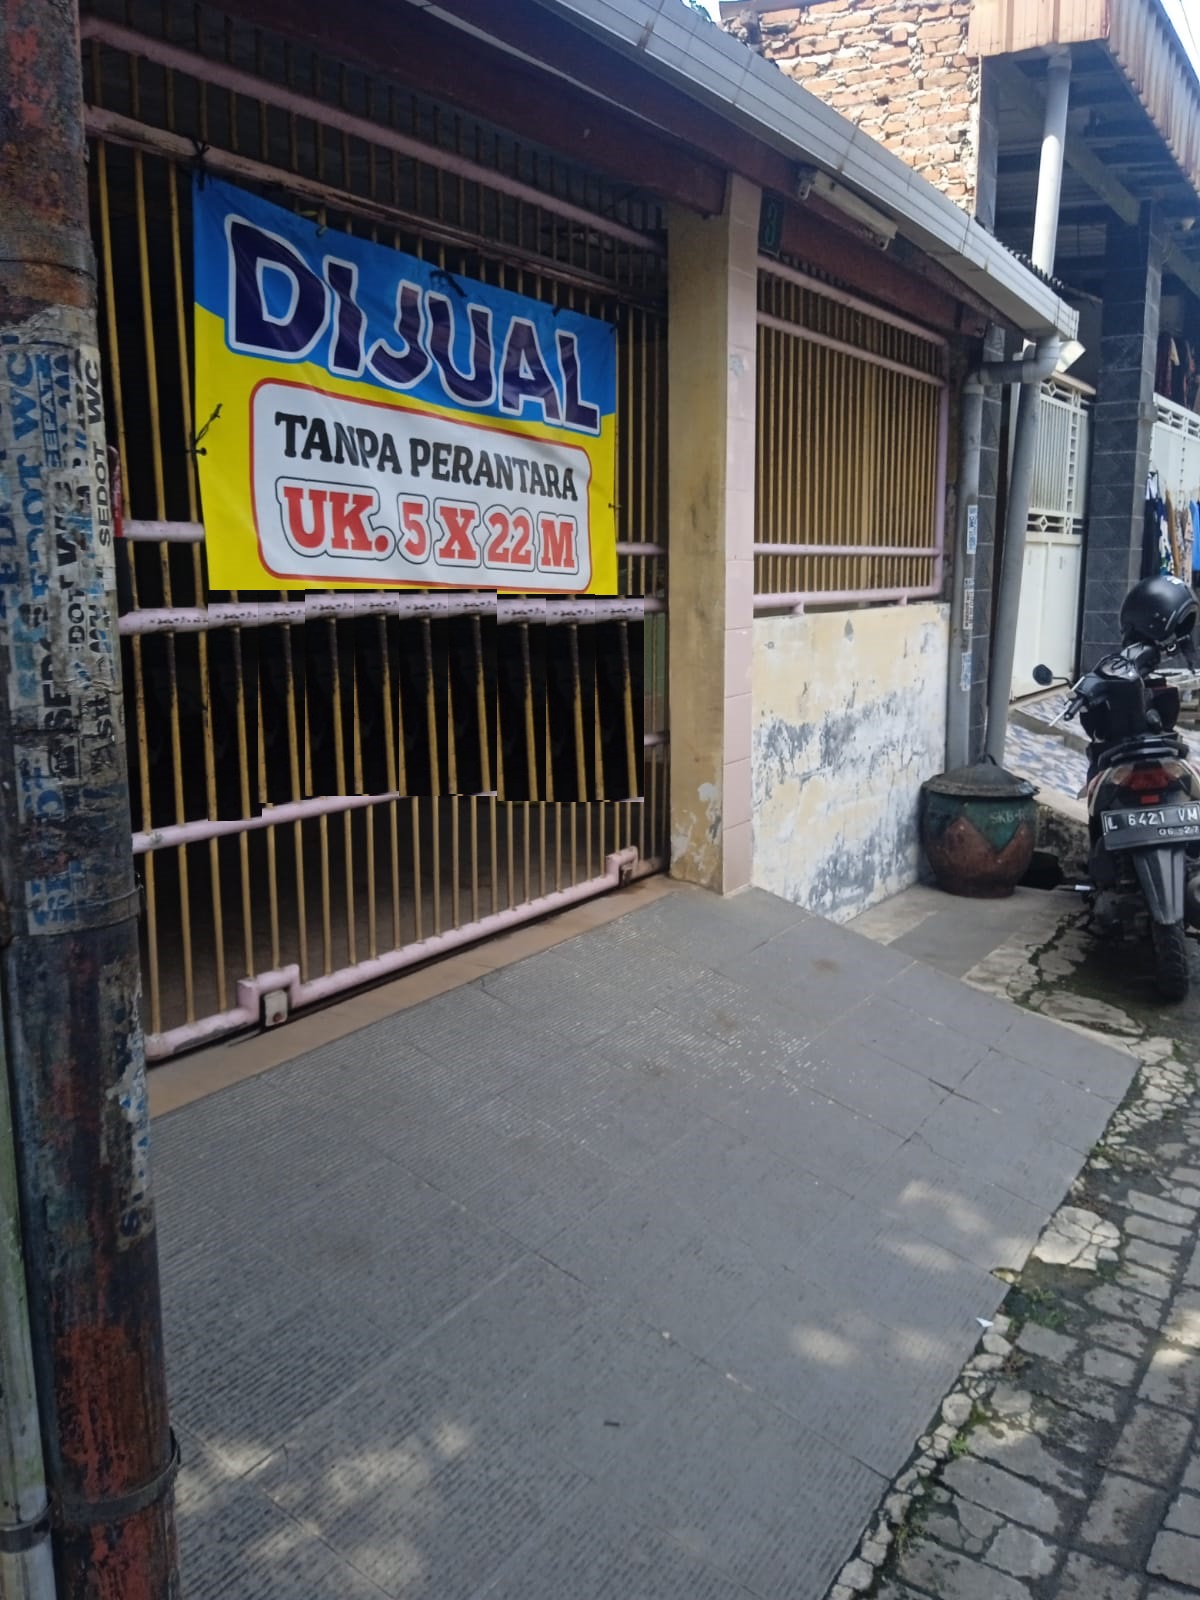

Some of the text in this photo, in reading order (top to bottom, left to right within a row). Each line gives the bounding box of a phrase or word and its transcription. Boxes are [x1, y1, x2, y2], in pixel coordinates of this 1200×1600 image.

[225, 214, 600, 436] DIJUAL
[85, 360, 113, 547] SEDOT WC
[274, 411, 579, 501] TANPA PERANTARA
[282, 485, 576, 570] UK. 5 X 22 M
[1128, 811, 1165, 826] 6421
